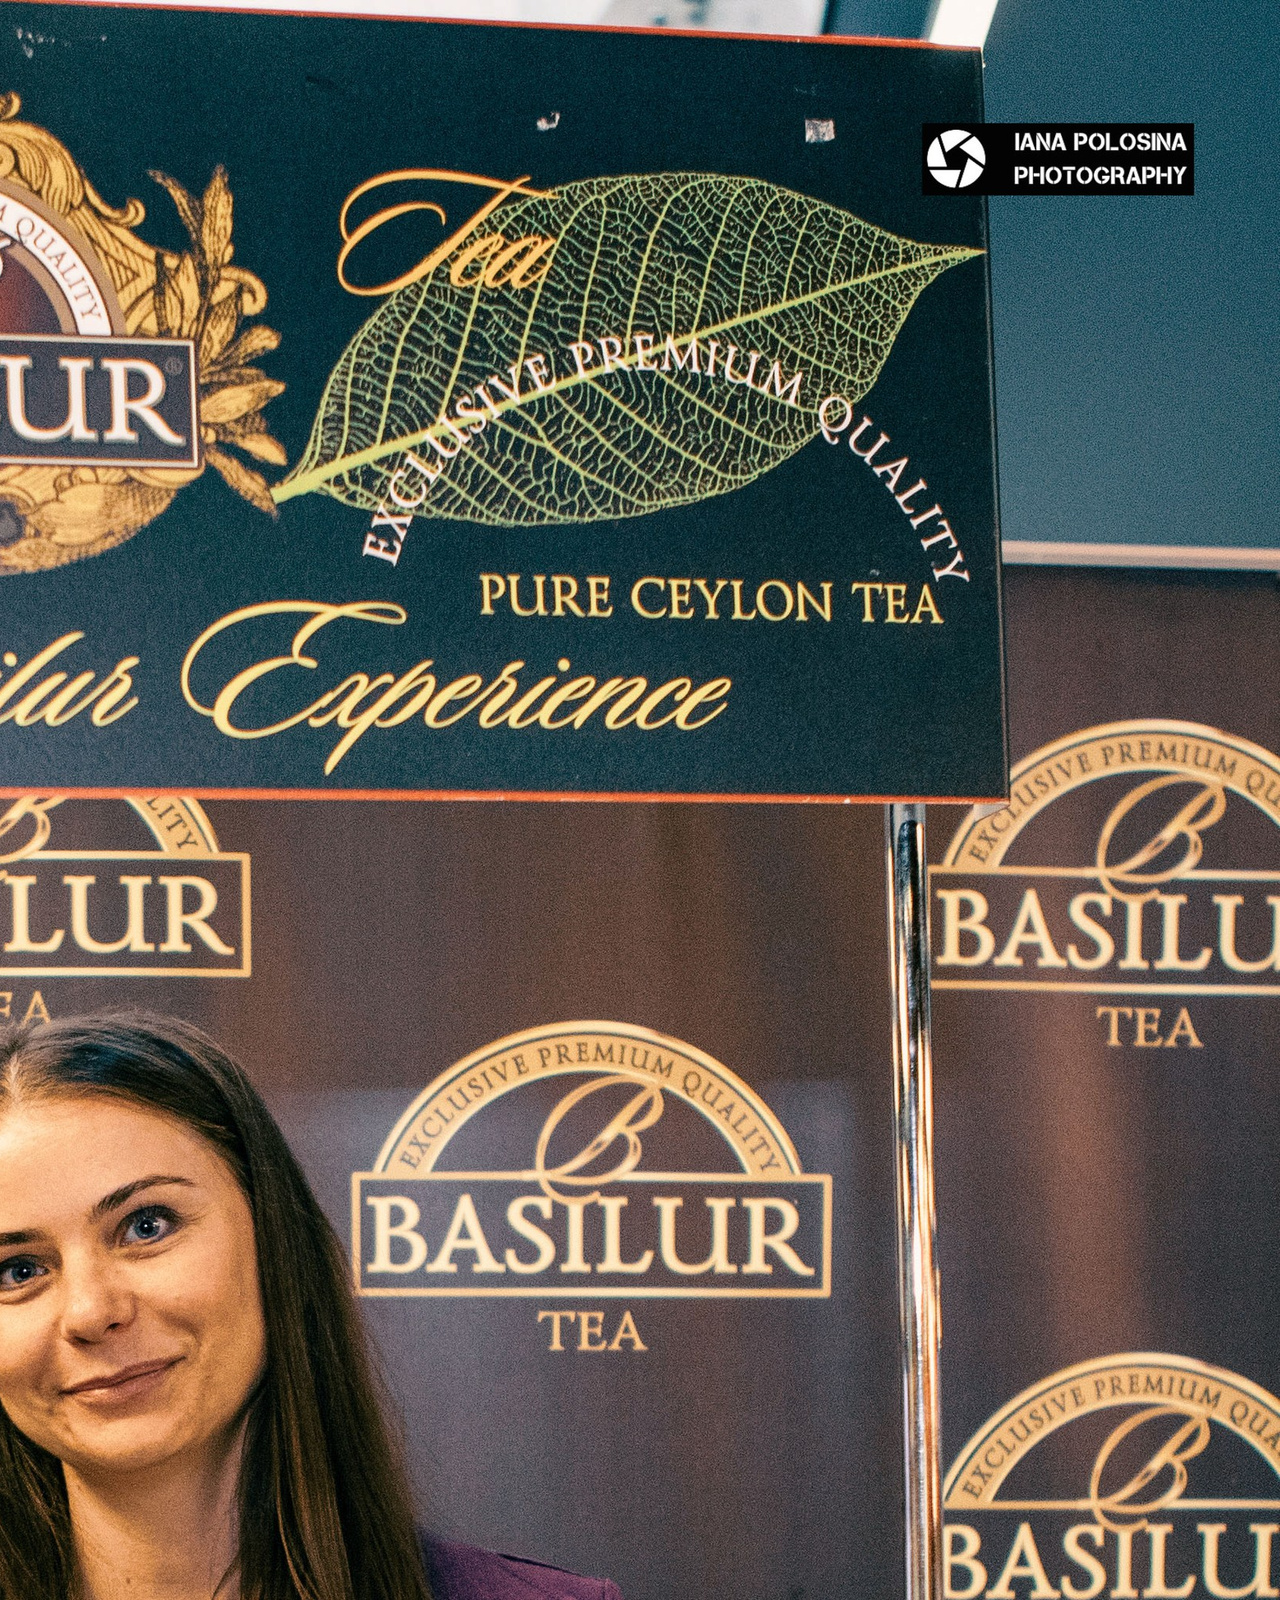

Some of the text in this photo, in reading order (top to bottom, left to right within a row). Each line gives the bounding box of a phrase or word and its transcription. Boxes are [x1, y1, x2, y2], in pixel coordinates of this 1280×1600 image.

[16, 215, 106, 322] QUALITY
[336, 168, 561, 297] Tea
[362, 335, 970, 585] EXCLUSIVE PREMIUM QUALITY
[479, 573, 945, 626] PURE CEYLON TEA
[181, 599, 731, 776] Experience
[971, 741, 1238, 863] EXCLUSIVE PREMIUM
[1096, 1005, 1204, 1049] TEA
[400, 1041, 782, 1173] EXCLUSIVE PREMIUM QUALITY
[366, 1193, 815, 1276] BASILUR
[537, 1309, 648, 1351] TEA
[962, 1374, 1221, 1499] EXCLUSIVE PREMIUM
